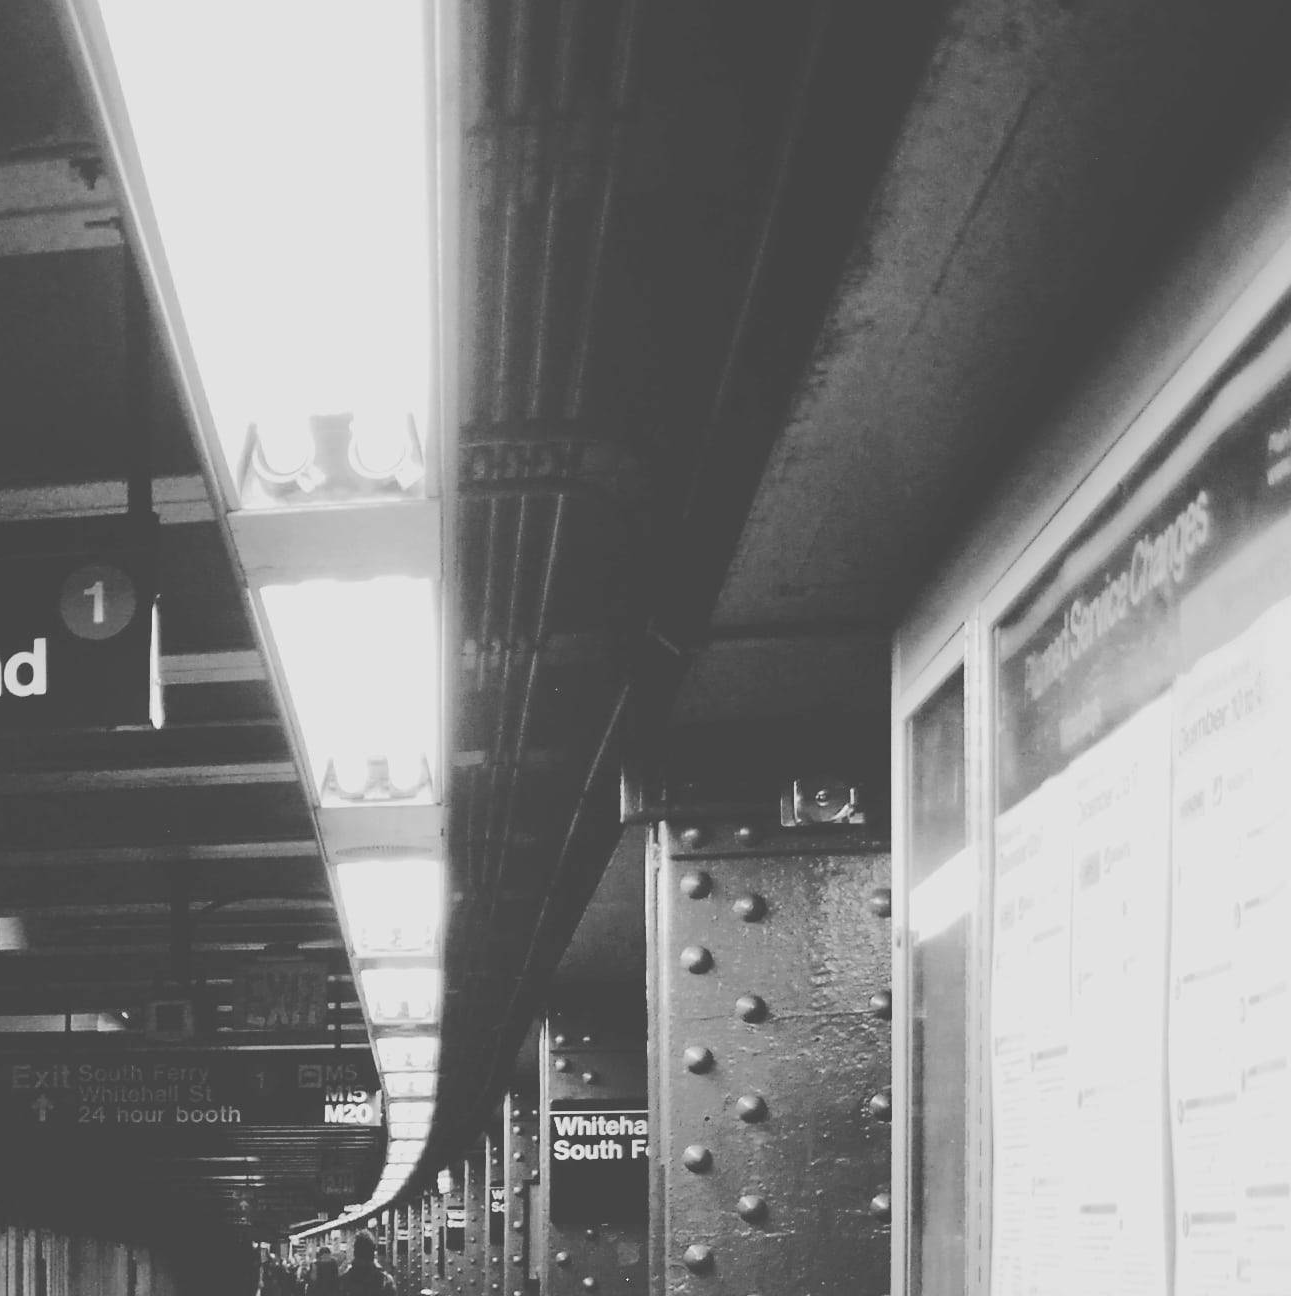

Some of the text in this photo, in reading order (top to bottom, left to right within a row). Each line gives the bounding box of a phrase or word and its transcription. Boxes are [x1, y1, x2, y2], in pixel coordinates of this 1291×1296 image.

[1070, 572, 1128, 660] Service
[1129, 494, 1209, 606] Changes
[83, 580, 104, 624] 1
[10, 1064, 71, 1090] Exit
[77, 1063, 209, 1085] South Ferry
[324, 1063, 358, 1081] M5
[77, 1084, 213, 1103] Whitehall St
[77, 1104, 242, 1124] 24 hour booth
[324, 1103, 374, 1124] M20
[553, 1139, 650, 1161] South F
